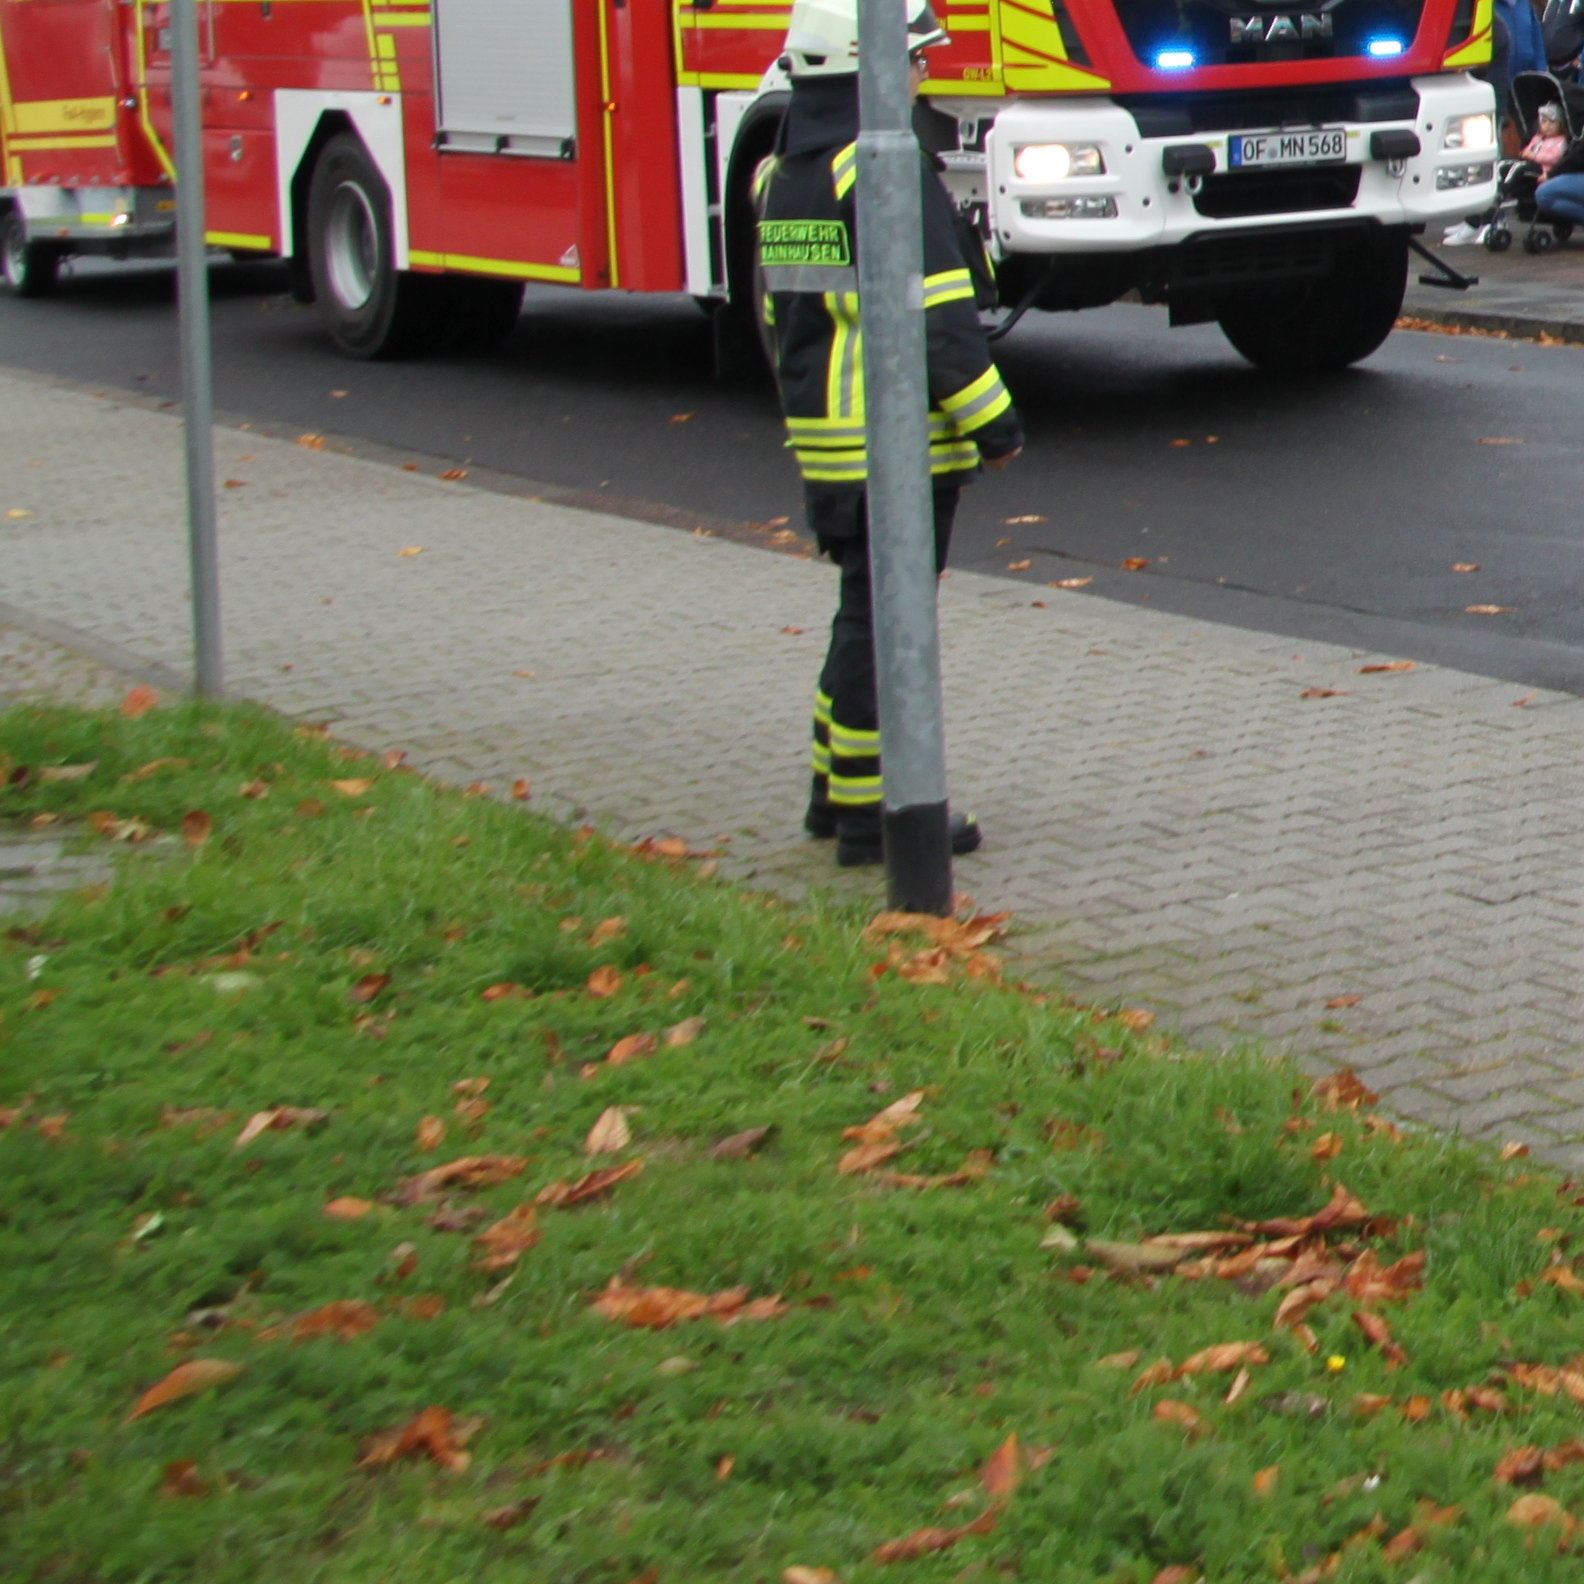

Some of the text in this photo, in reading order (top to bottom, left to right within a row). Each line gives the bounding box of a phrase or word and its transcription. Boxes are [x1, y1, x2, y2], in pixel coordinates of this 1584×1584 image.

[1229, 13, 1334, 44] MAN
[1243, 132, 1343, 161] OF MN 568
